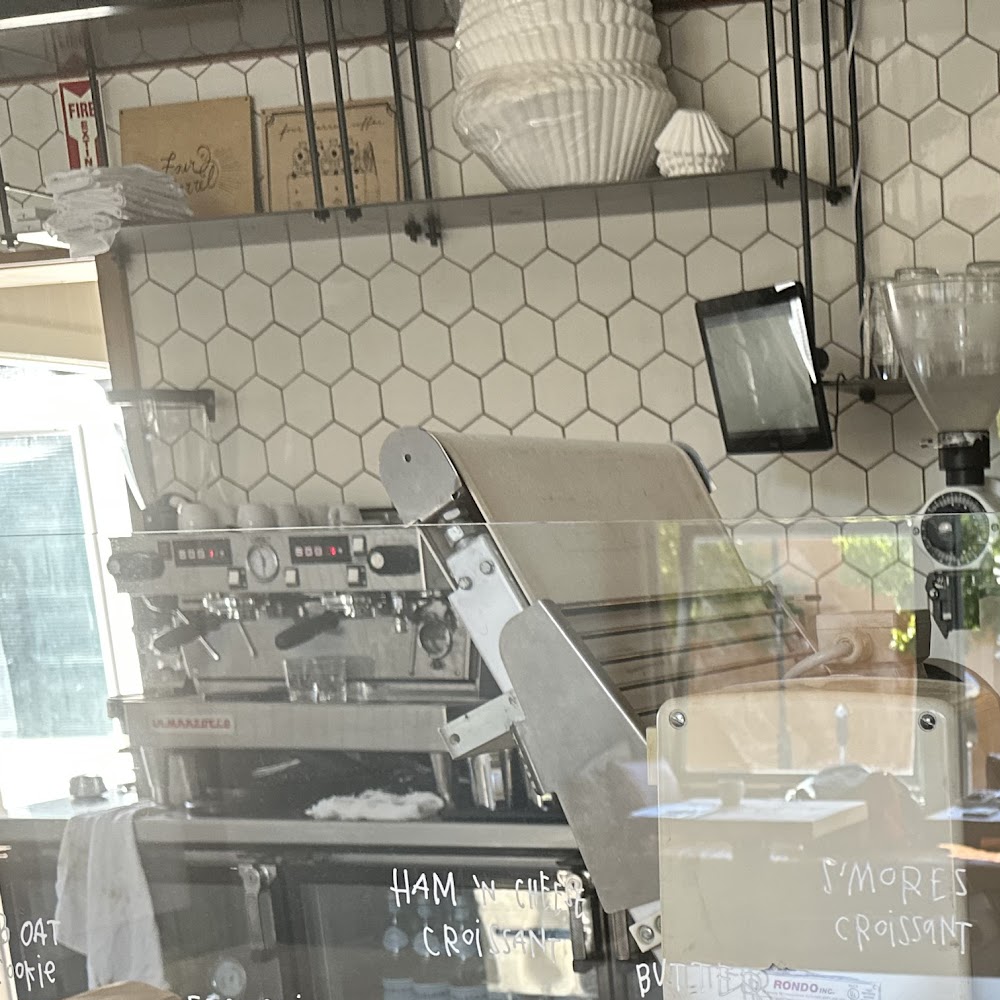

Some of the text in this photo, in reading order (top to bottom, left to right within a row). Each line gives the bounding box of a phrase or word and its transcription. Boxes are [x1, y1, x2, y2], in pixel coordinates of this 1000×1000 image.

[68, 101, 95, 118] FIRE
[390, 868, 457, 907] HAM
[822, 857, 968, 904] S'MORES
[20, 917, 61, 946] OAT
[773, 979, 819, 993] RONDO
